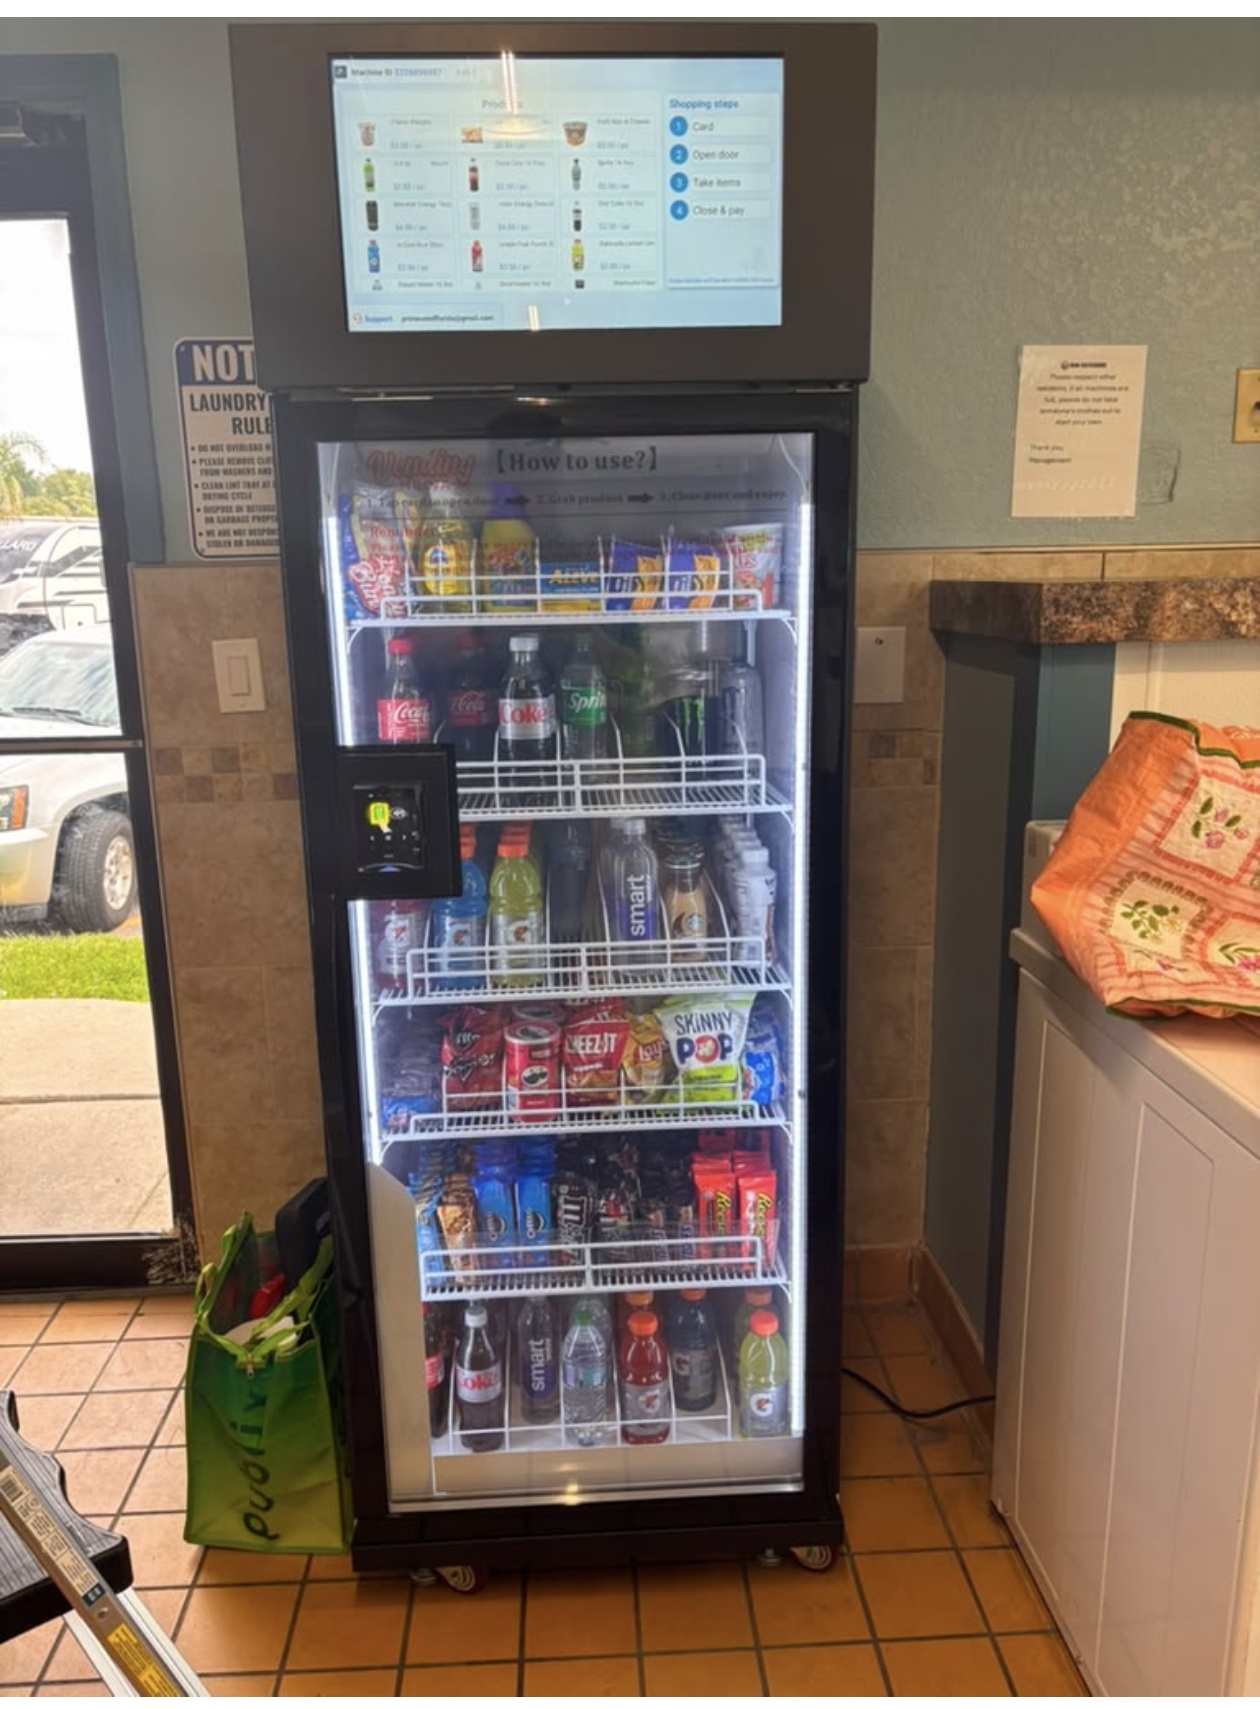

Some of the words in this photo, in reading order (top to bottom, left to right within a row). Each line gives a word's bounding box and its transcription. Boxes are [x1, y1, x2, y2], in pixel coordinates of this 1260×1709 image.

[669, 99, 711, 111] Shopping
[714, 99, 739, 110] steps
[692, 121, 714, 132] Card
[693, 149, 716, 162] Open
[718, 150, 739, 160] door
[692, 177, 714, 188] Take
[716, 177, 741, 188] items
[692, 205, 718, 215] Close
[719, 205, 727, 215] &
[728, 206, 745, 217] pay
[365, 314, 393, 325] Support
[189, 393, 266, 412] LAUNDRY
[210, 443, 224, 452] NOT
[226, 443, 263, 452] OVERLOAD
[198, 457, 225, 467] PLEASE
[226, 457, 257, 466] REMOVE
[566, 453, 588, 471] to
[199, 468, 220, 476] FROM
[222, 467, 256, 476] WASHERS
[201, 481, 223, 490] CLEAN
[224, 481, 240, 490] LINT
[241, 480, 259, 489] TRAY
[202, 491, 229, 500] DRYING
[230, 491, 252, 500] CYCLE
[578, 493, 624, 505] product
[203, 505, 233, 514] DISPOSE
[216, 515, 250, 524] GARBAGE
[206, 538, 232, 548] STOLEN
[625, 874, 646, 937] smart
[676, 1033, 735, 1065] POP
[528, 1338, 546, 1392] smart
